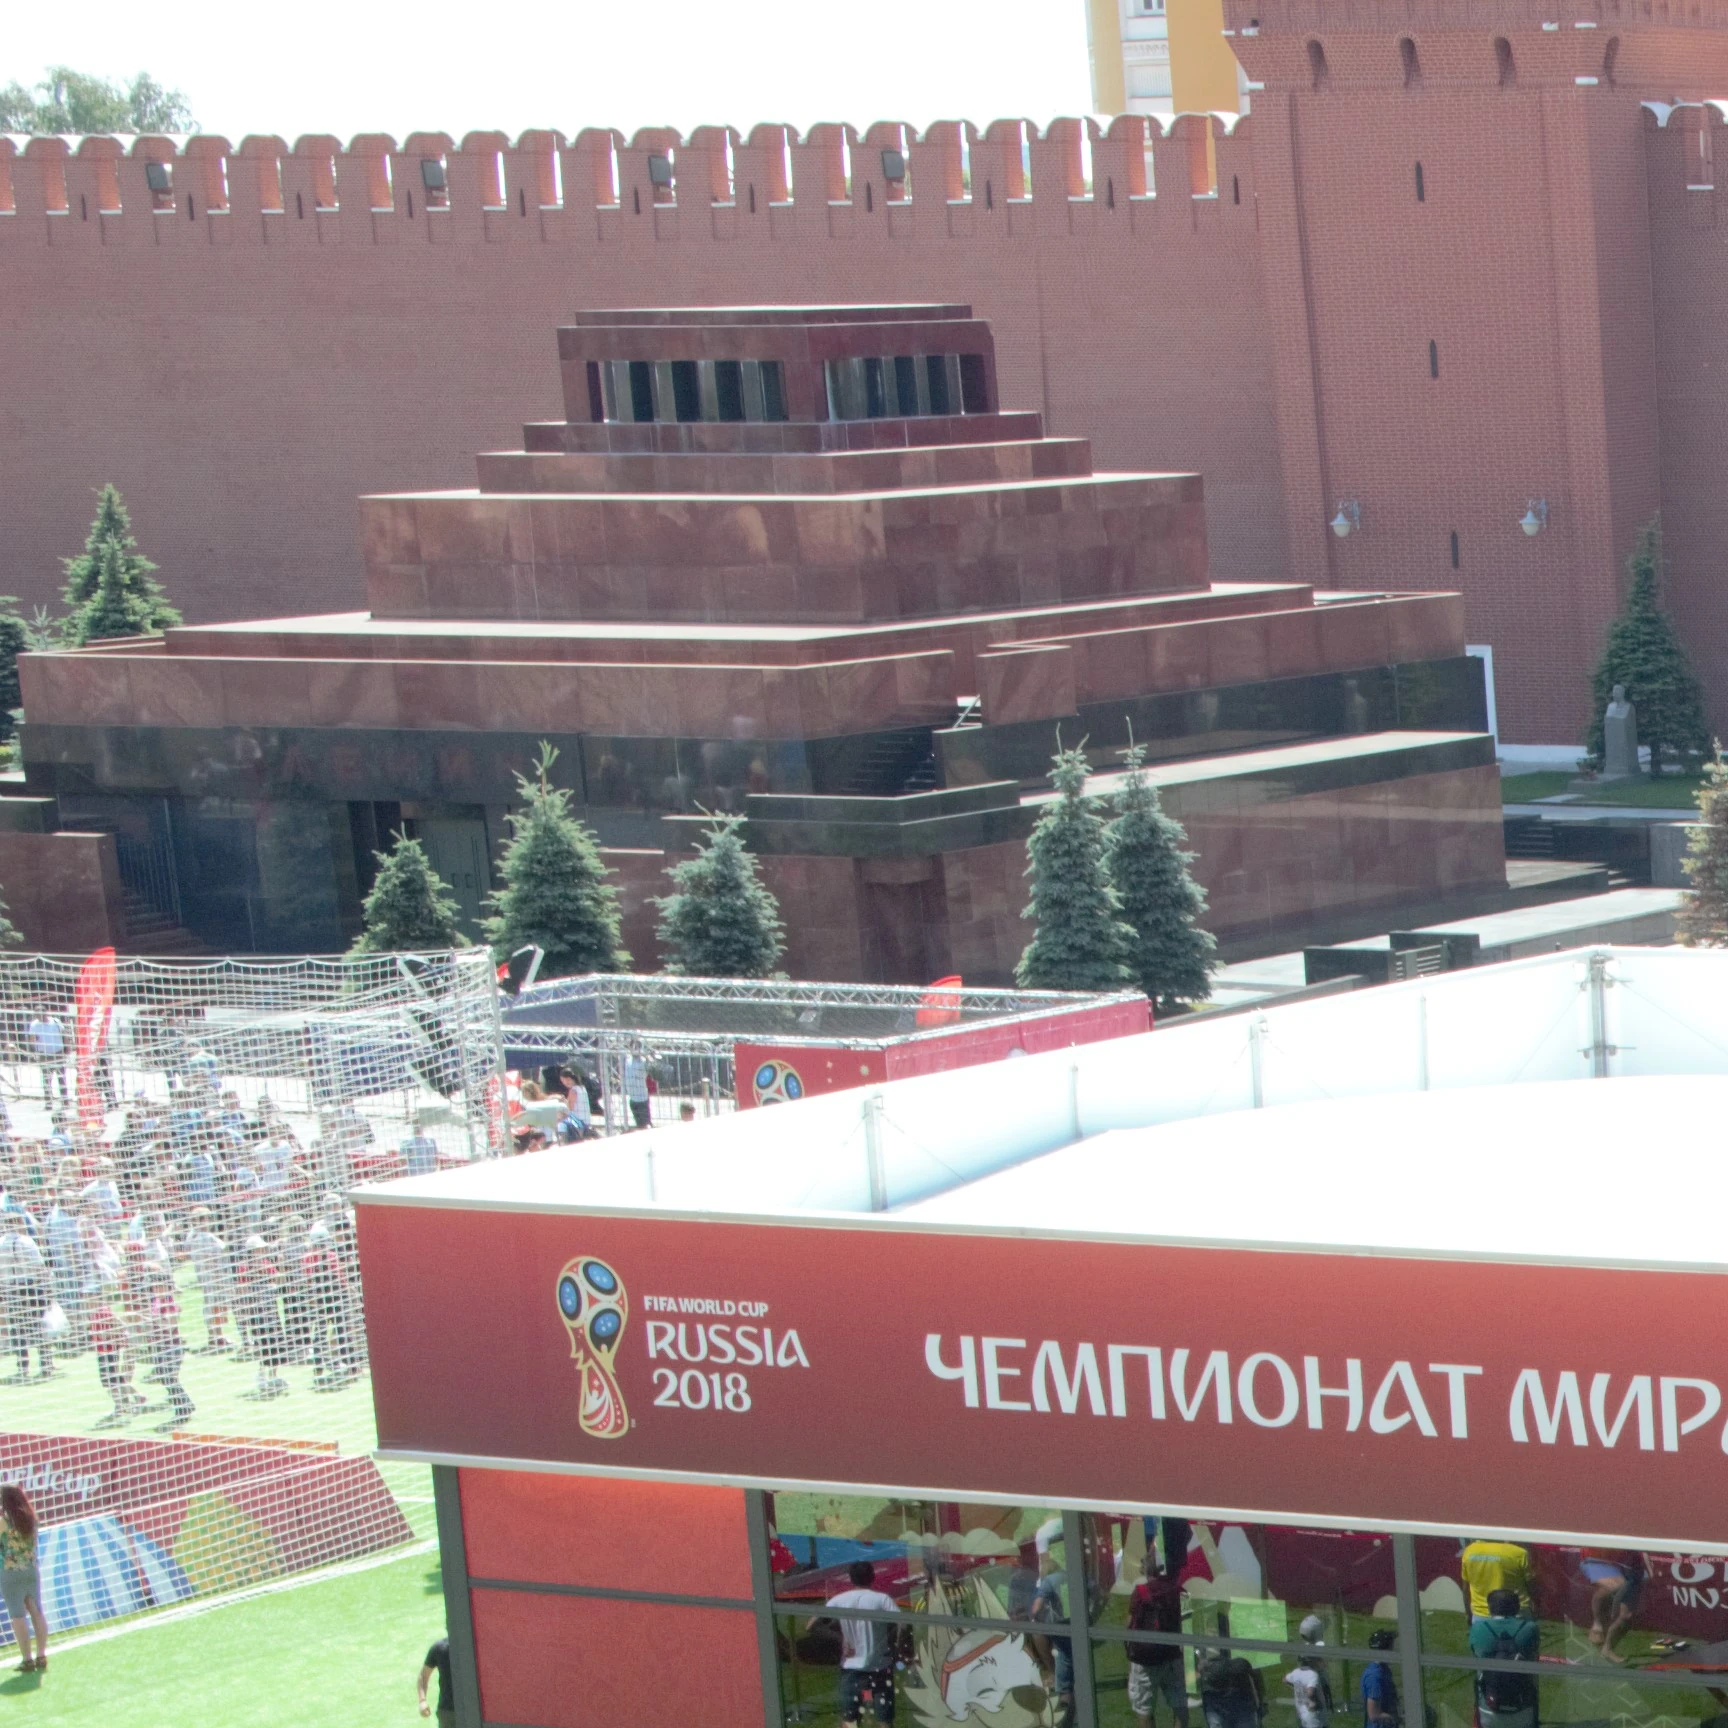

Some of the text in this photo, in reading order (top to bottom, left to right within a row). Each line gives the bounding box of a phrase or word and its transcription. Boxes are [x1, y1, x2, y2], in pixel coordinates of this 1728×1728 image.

[643, 1295, 769, 1317] FIFA WORLD CUP
[646, 1320, 810, 1368] RUSSIA
[652, 1368, 752, 1412] 2018
[925, 1333, 1483, 1439] ЧЕМПИОНАТ
